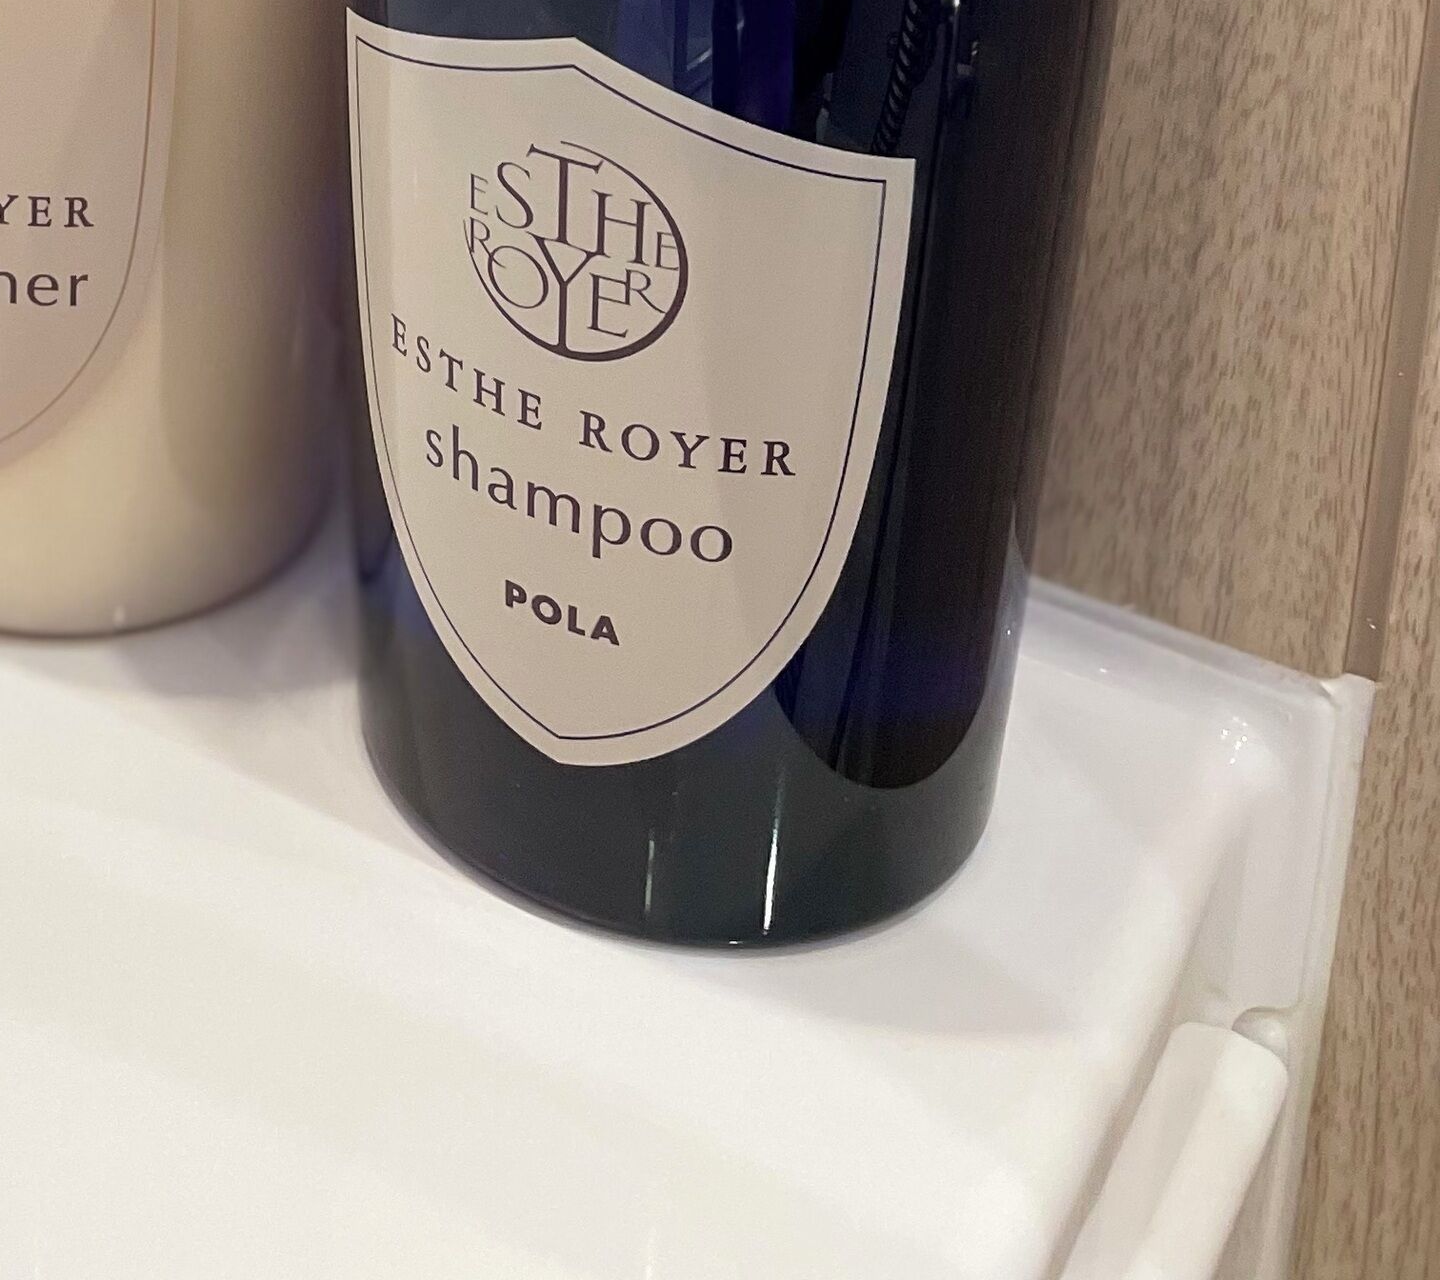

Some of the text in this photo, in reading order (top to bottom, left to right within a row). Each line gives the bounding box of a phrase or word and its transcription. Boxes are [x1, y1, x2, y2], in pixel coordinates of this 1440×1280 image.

[390, 313, 796, 478] ESTHE ROYER
[425, 425, 734, 559] shampoo
[504, 579, 621, 646] POLA
